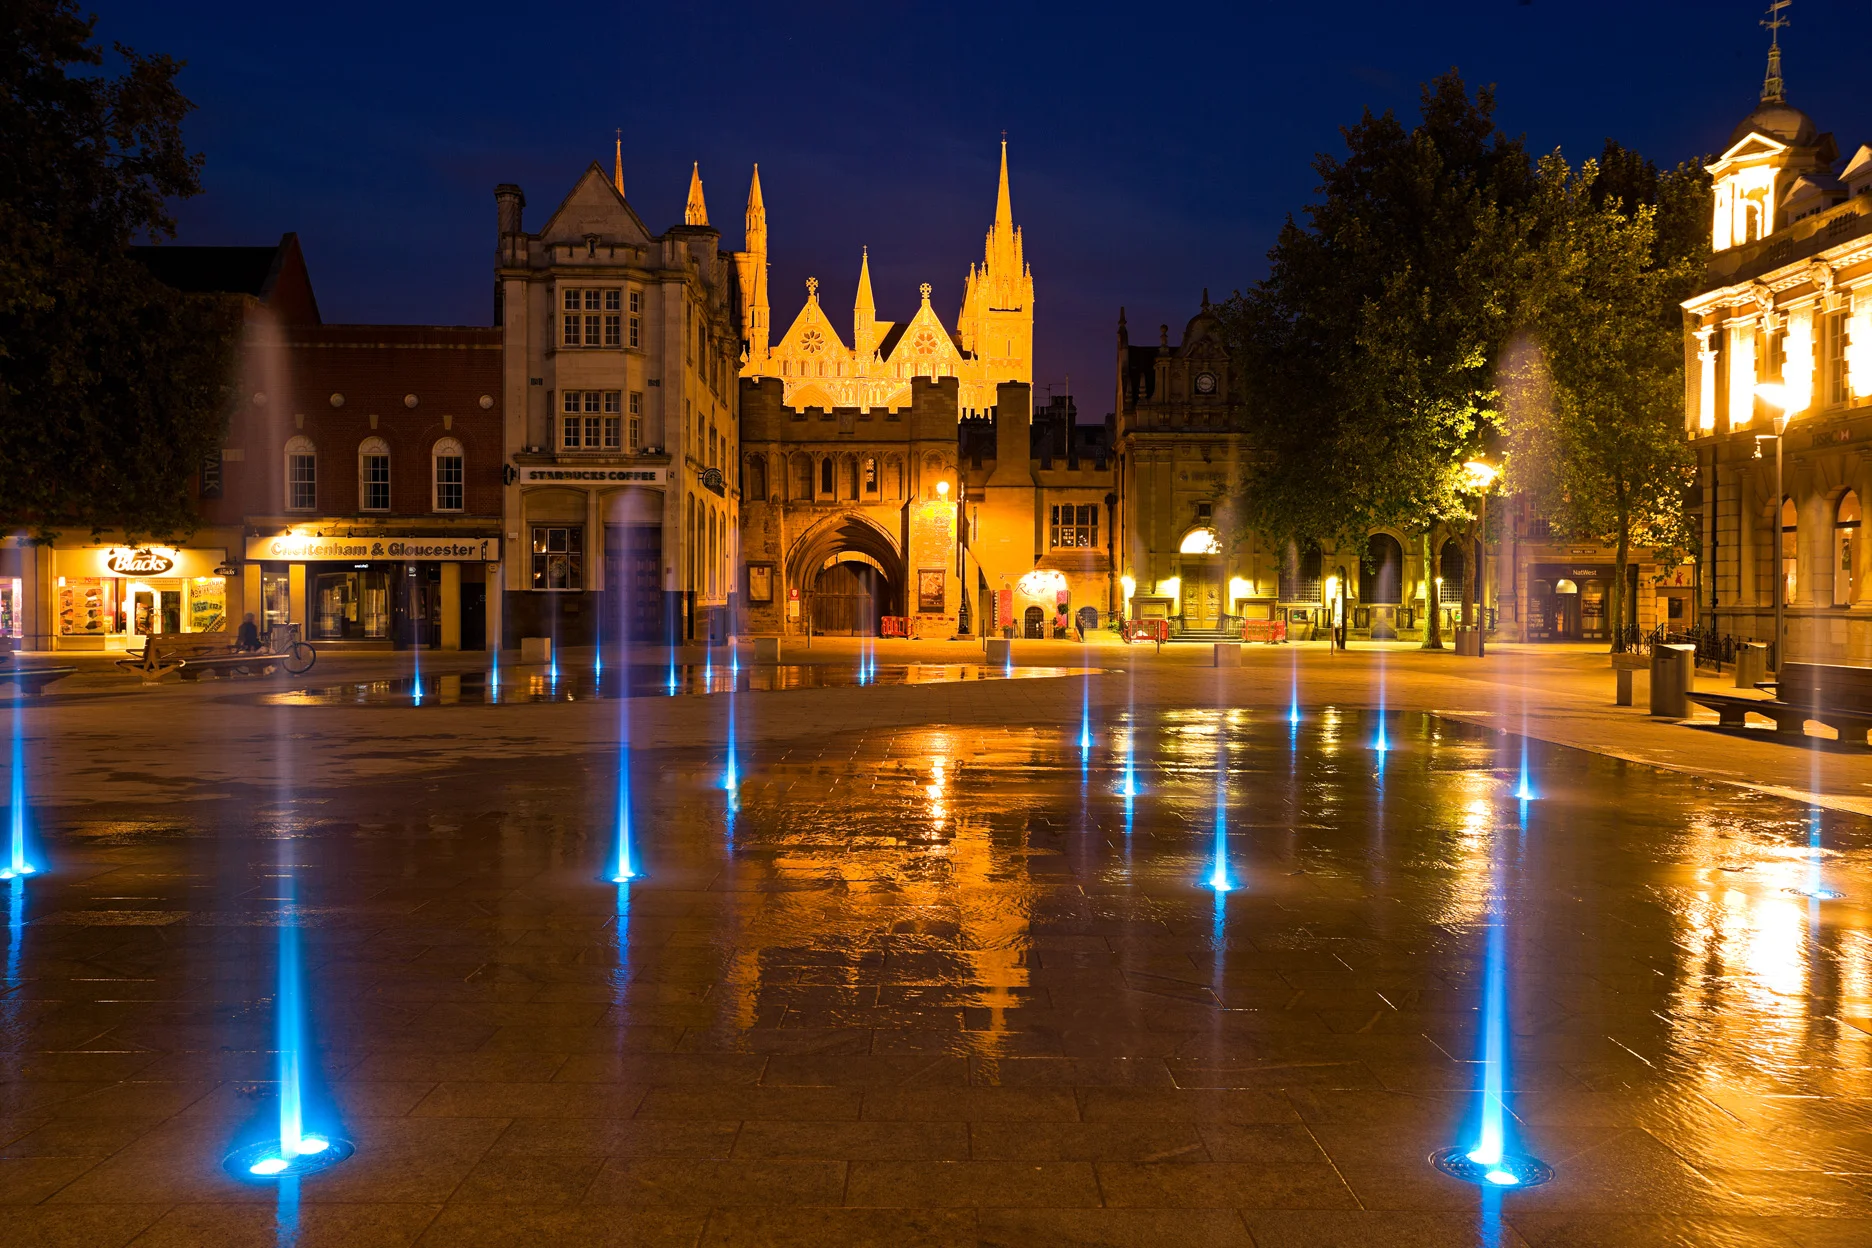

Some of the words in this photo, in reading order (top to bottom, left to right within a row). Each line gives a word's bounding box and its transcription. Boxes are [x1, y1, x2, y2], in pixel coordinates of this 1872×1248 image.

[529, 471, 606, 480] STARBUCKS
[608, 471, 656, 480] COFFEE
[371, 542, 384, 556] &
[388, 542, 475, 556] Gloucester
[114, 554, 168, 571] Blacks
